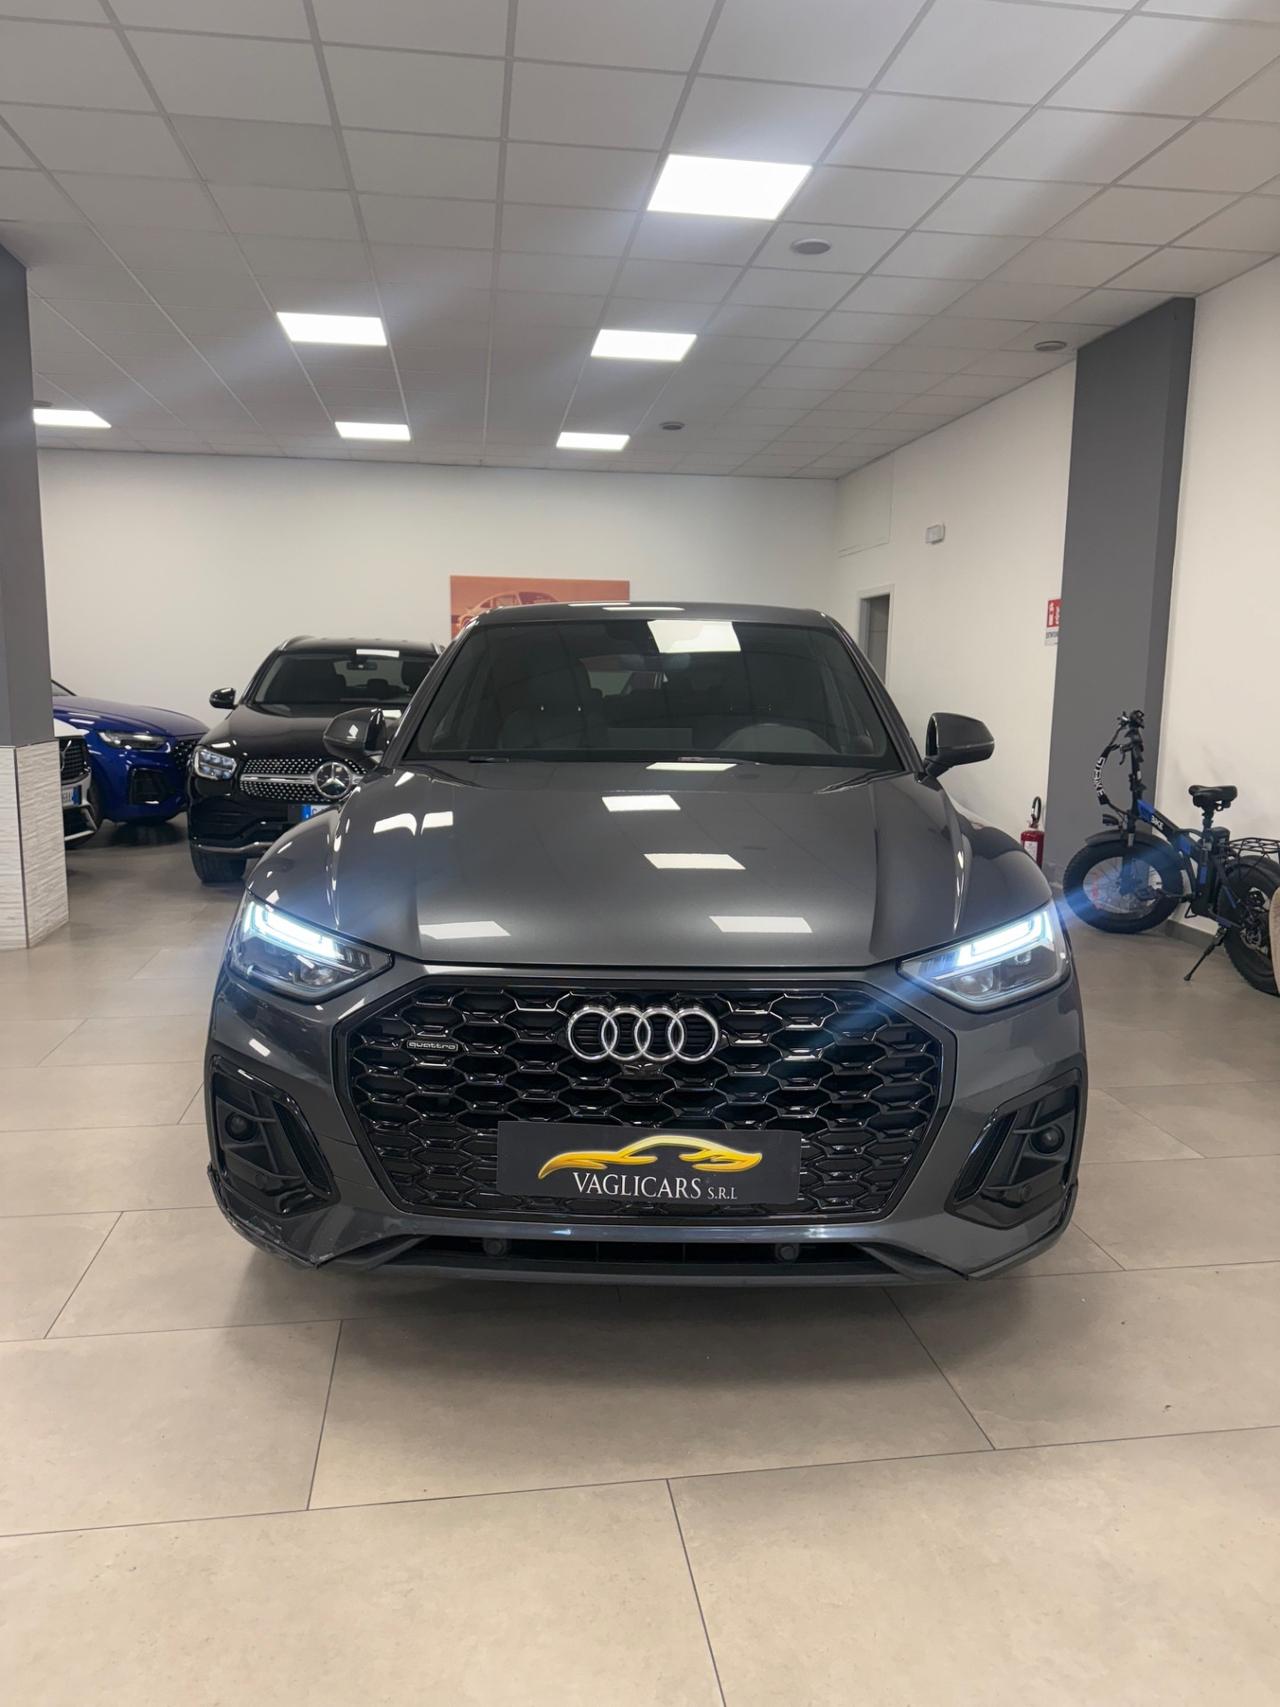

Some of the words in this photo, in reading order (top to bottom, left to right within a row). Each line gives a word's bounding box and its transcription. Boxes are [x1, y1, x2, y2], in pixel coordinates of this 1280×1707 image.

[408, 1041, 456, 1050] quattro
[572, 1172, 702, 1200] VAGLICARS
[708, 1186, 738, 1200] S.R.L
